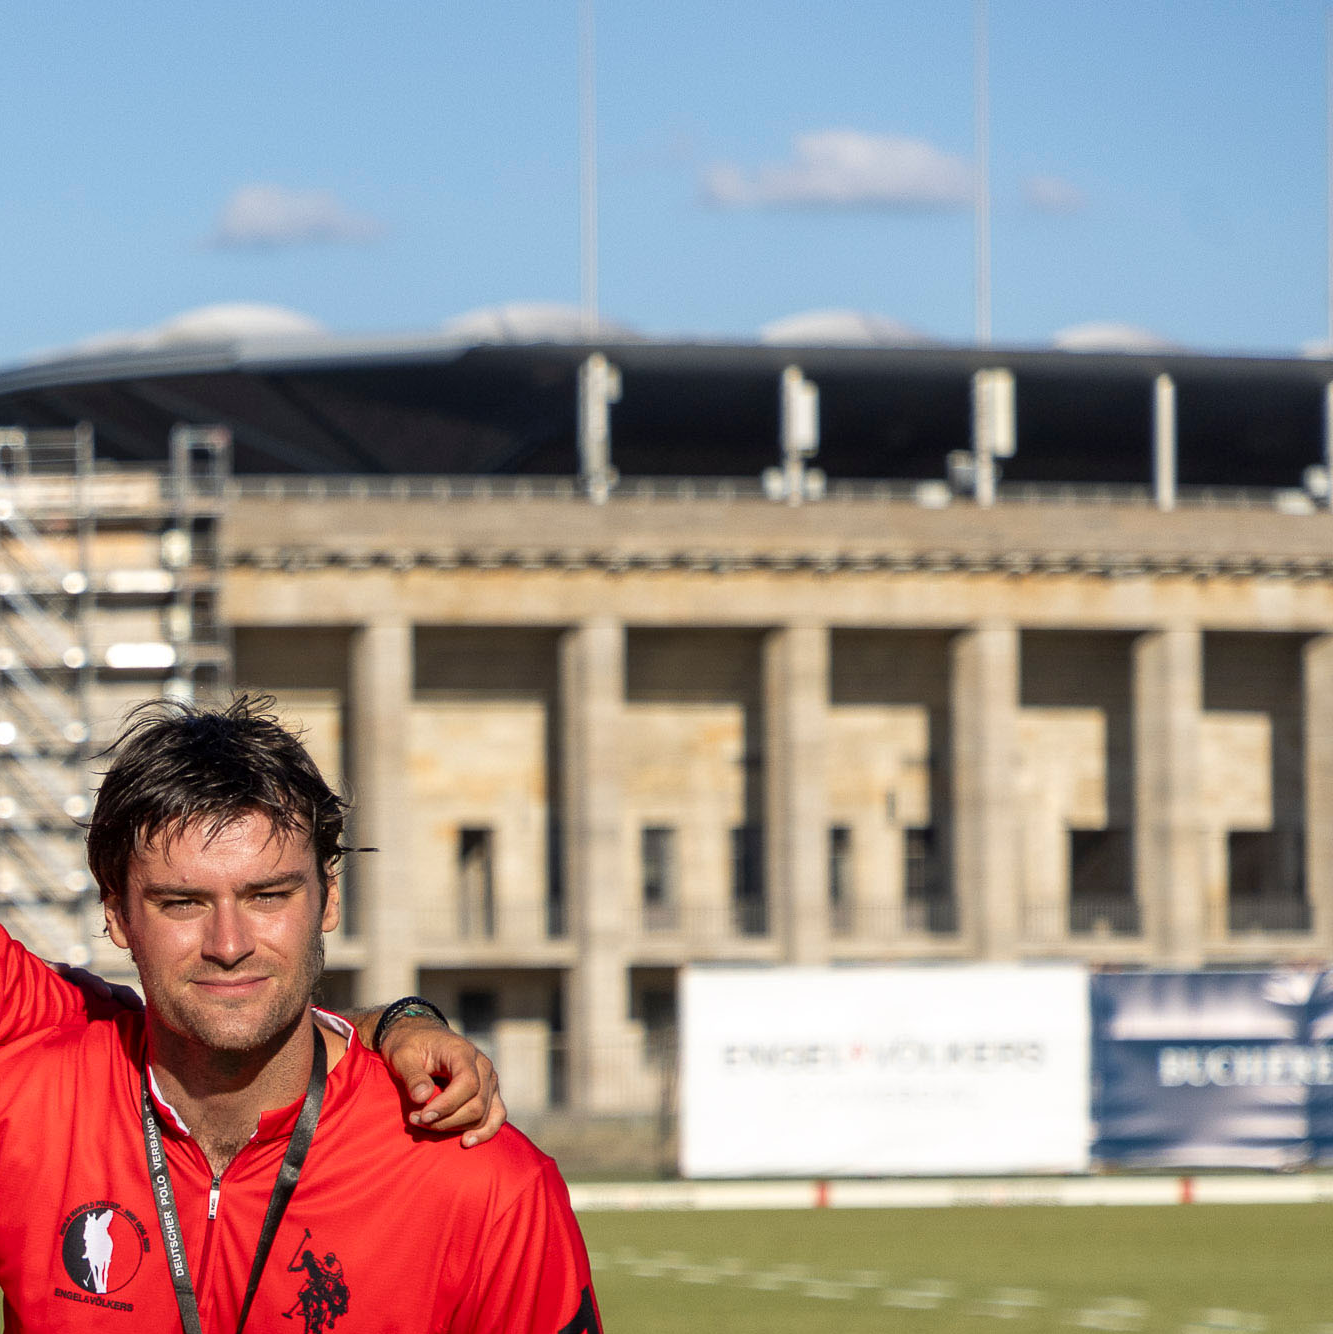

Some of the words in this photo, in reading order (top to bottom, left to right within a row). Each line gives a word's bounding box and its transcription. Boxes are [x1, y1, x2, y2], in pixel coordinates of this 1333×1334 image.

[147, 1117, 163, 1171] VERBAND
[156, 1175, 170, 1206] POLO
[162, 1210, 184, 1277] DEUTSCHER
